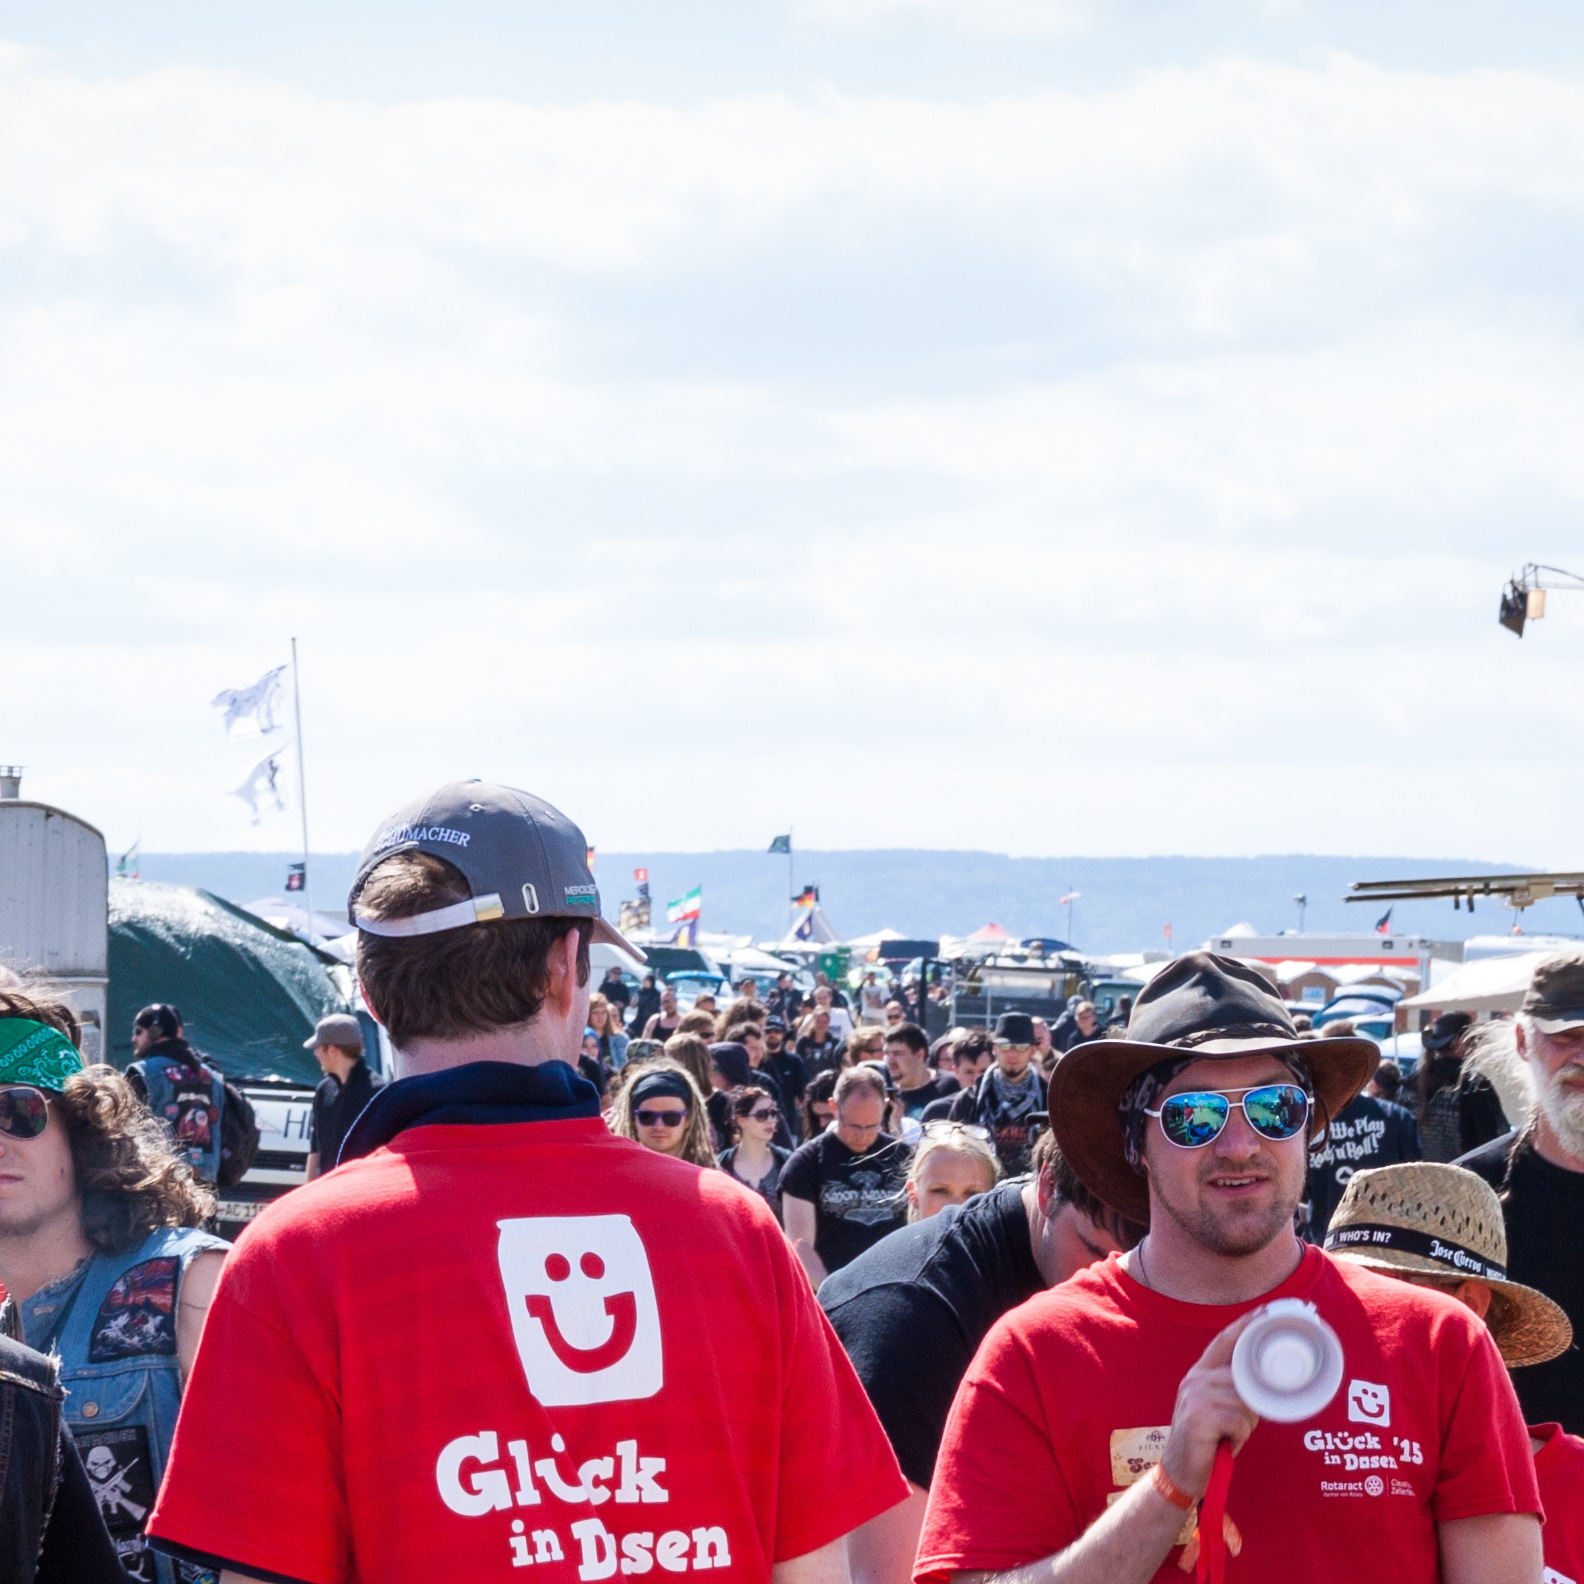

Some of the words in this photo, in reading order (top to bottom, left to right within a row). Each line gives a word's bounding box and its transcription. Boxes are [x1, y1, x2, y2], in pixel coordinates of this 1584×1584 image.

[1330, 1121, 1356, 1140] We
[1354, 1115, 1386, 1139] Play
[1338, 1230, 1370, 1243] WHO'S
[1372, 1230, 1392, 1244] IN?
[1303, 1429, 1382, 1452] Glück
[1392, 1436, 1424, 1465] '15
[1324, 1451, 1342, 1465] in
[1320, 1480, 1364, 1492] Rotaract
[509, 1519, 565, 1567] in
